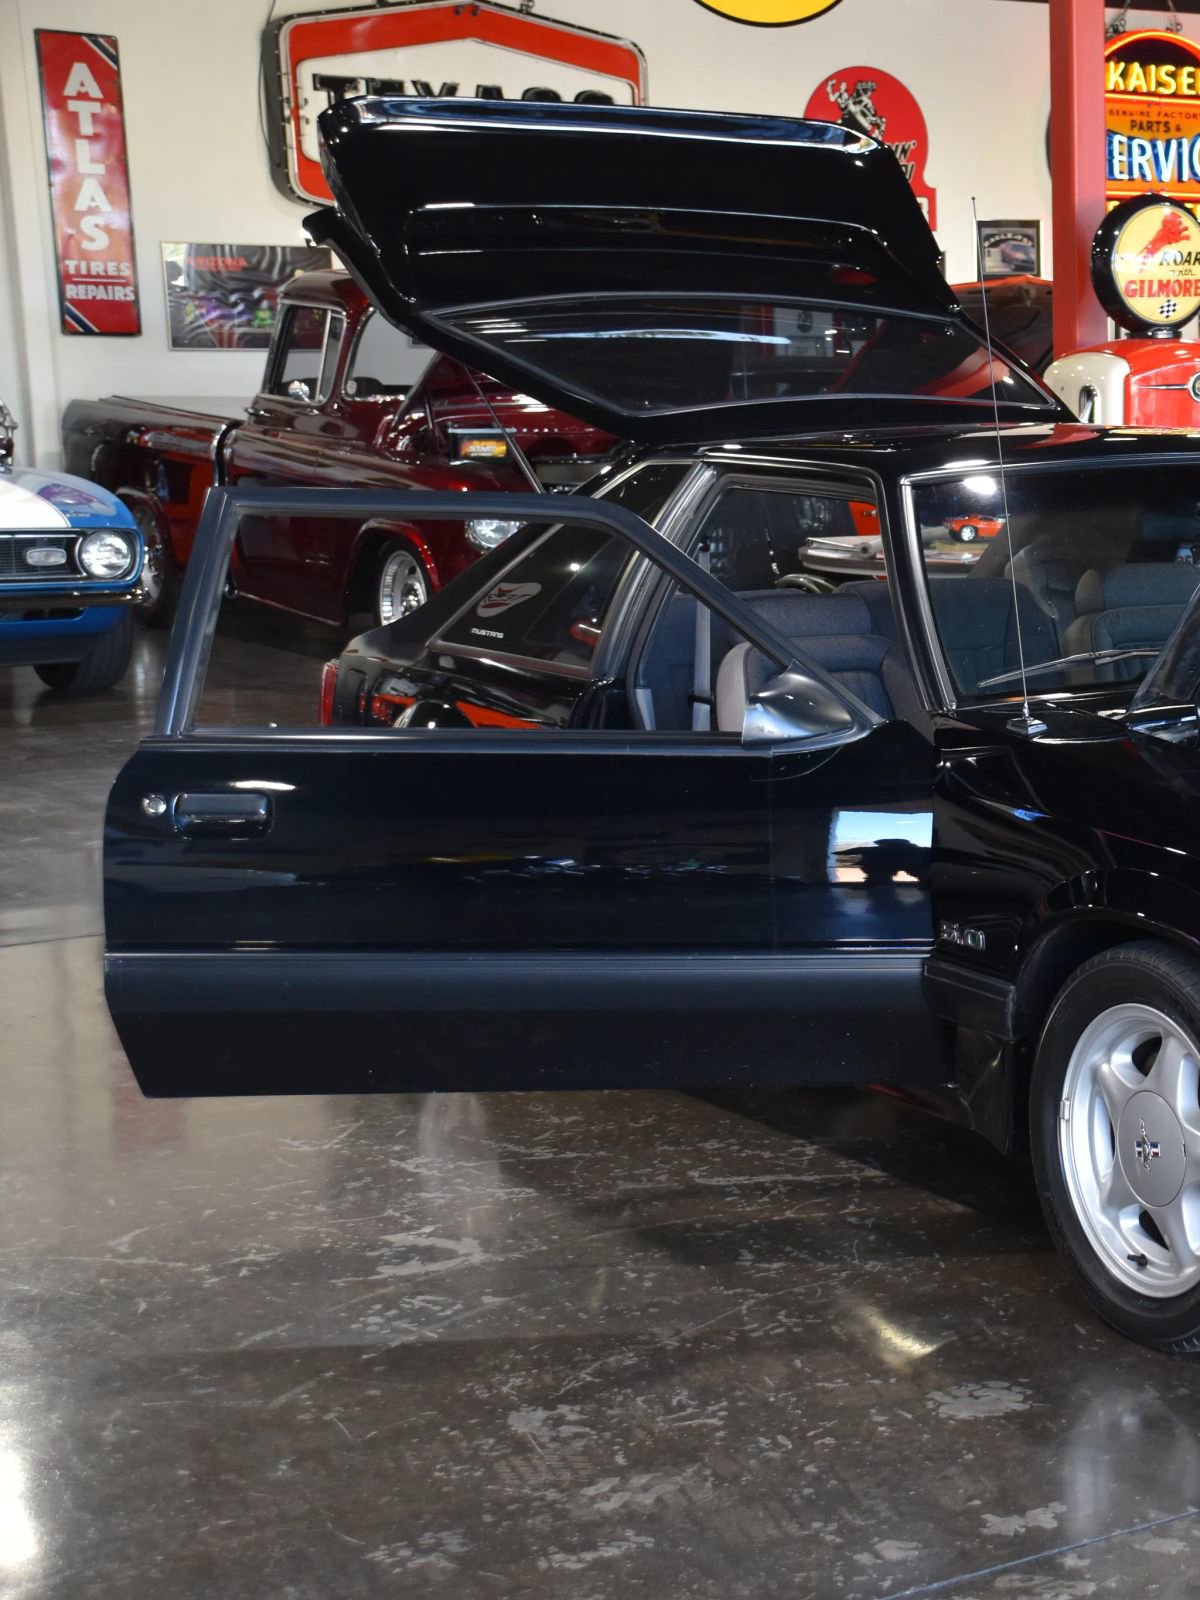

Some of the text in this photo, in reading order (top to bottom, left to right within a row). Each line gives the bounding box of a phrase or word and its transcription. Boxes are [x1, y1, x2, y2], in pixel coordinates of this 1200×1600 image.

[1108, 108, 1151, 118] GENUINE
[1130, 120, 1171, 133] PARTS
[63, 62, 112, 251] ATLAS
[65, 260, 131, 276] TIRES
[65, 284, 135, 301] REPAIRS
[471, 627, 504, 639] MUSTANG
